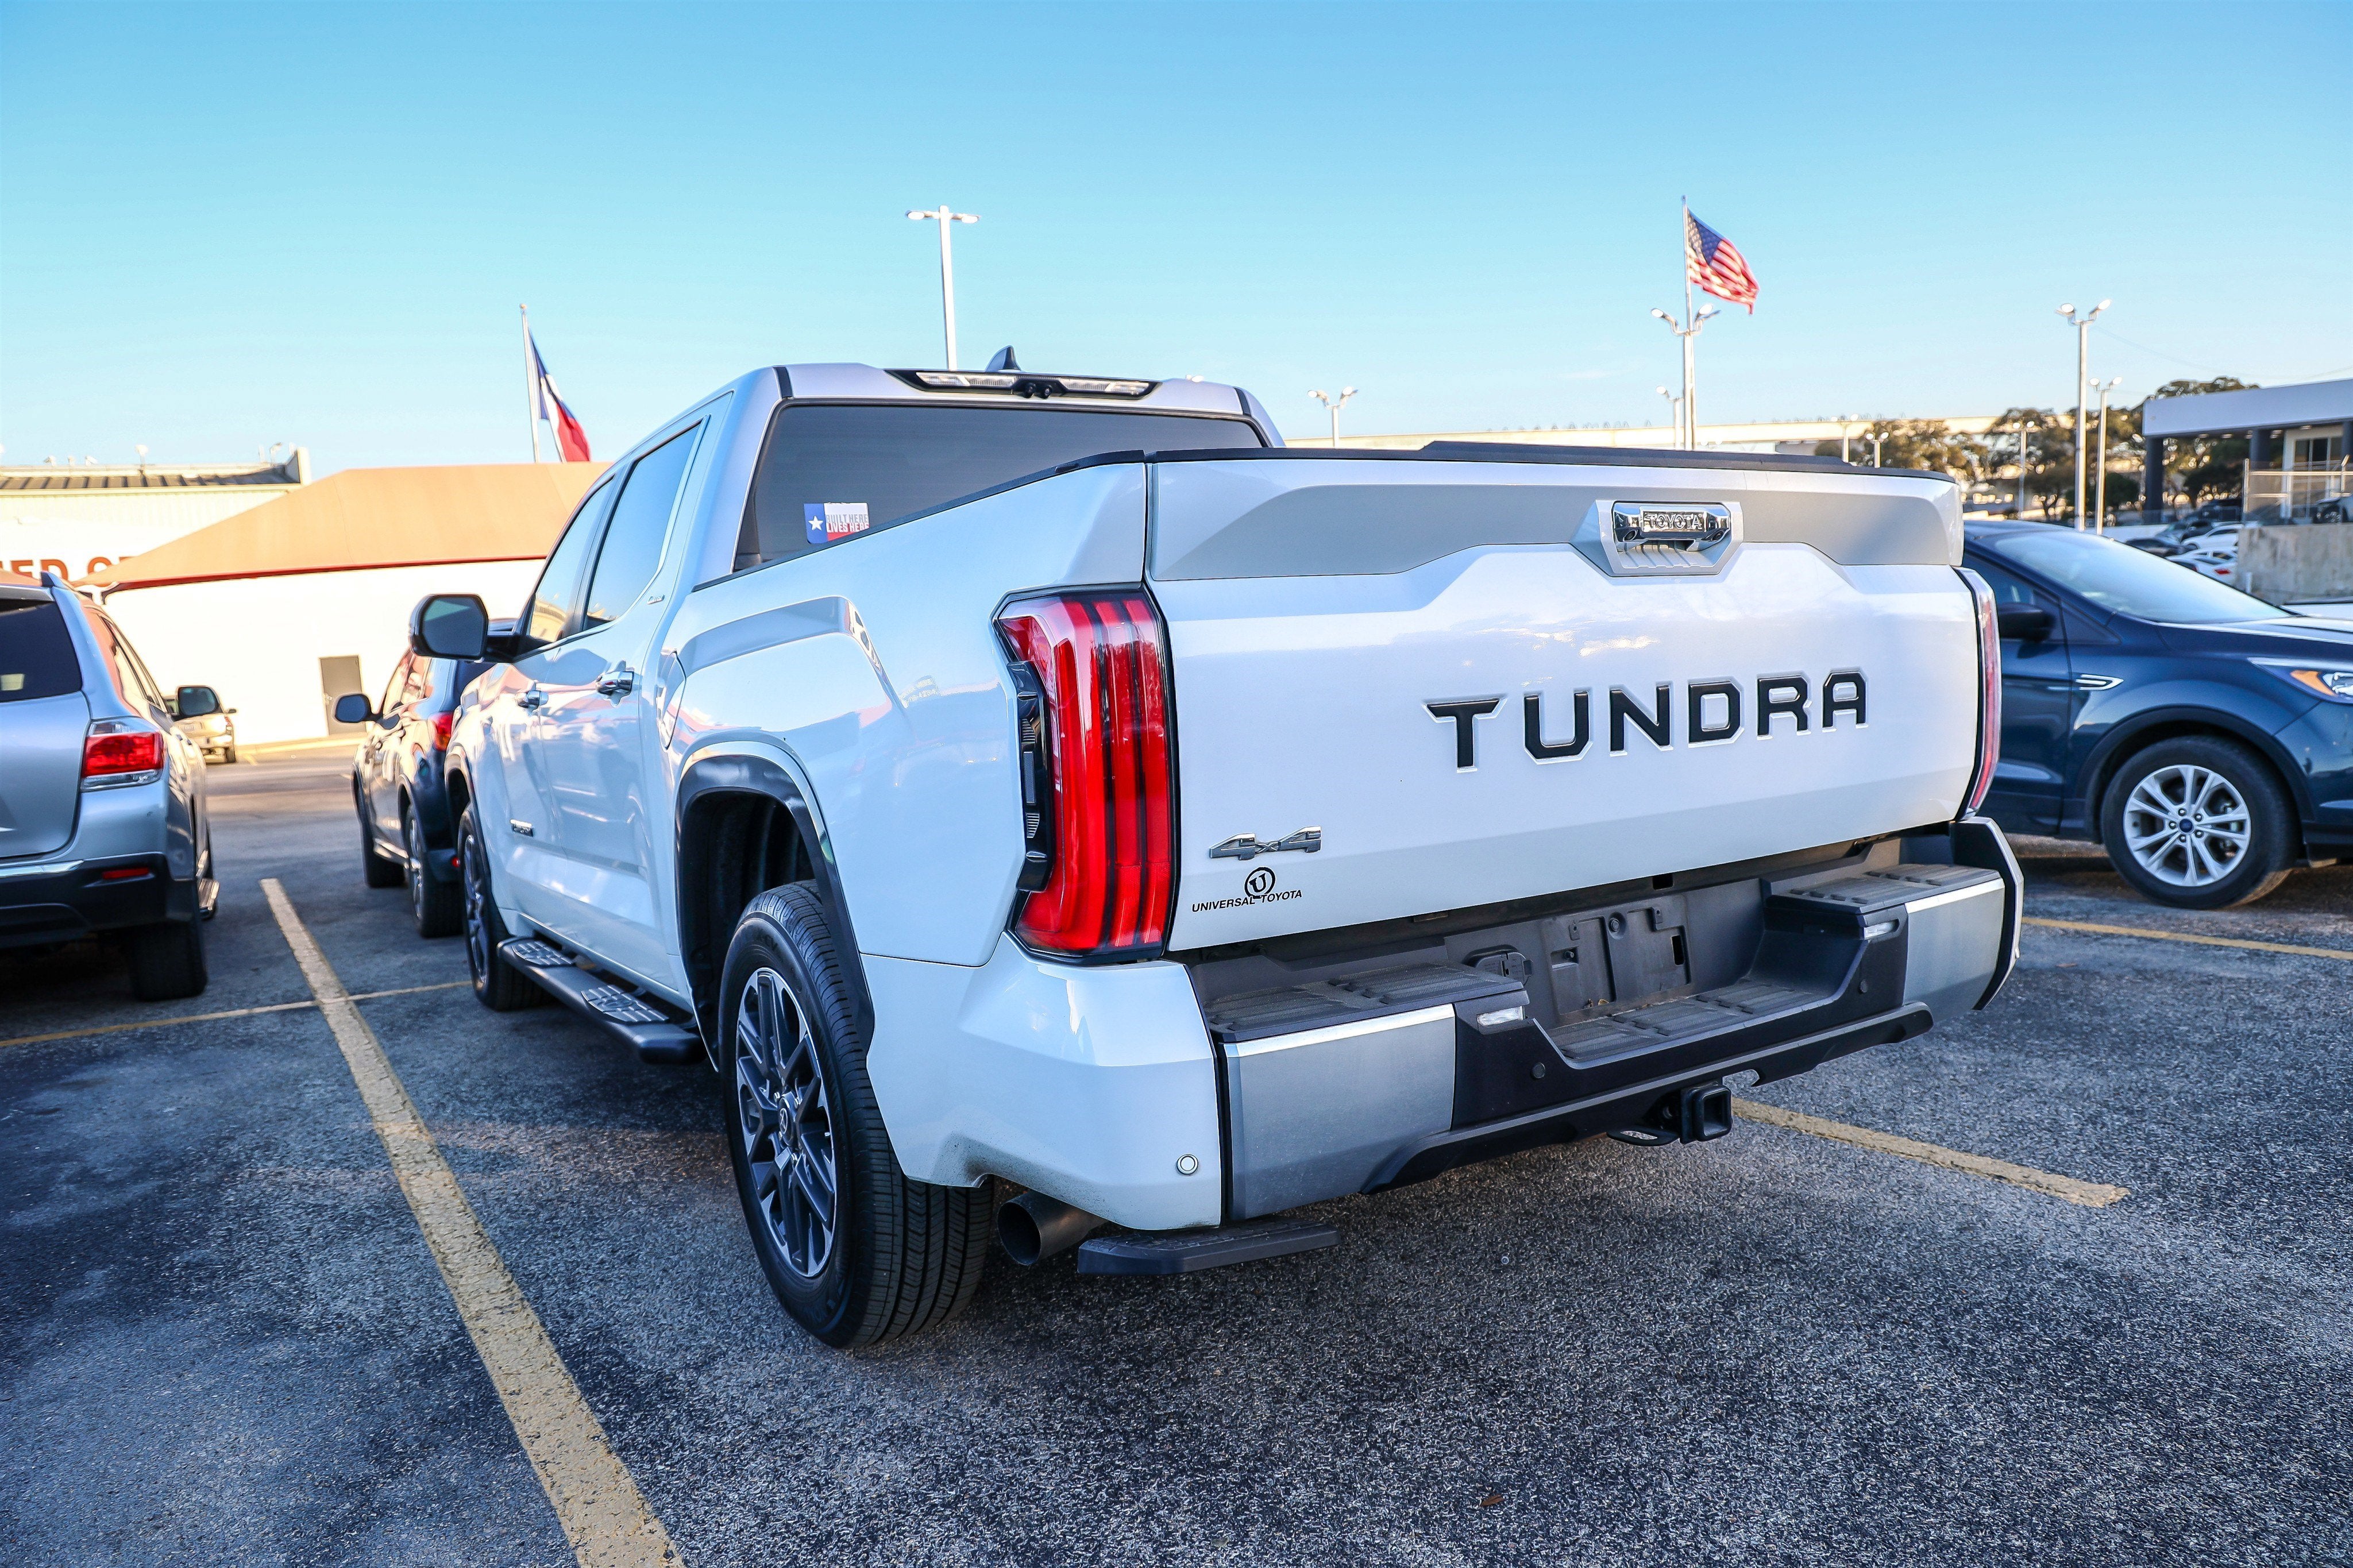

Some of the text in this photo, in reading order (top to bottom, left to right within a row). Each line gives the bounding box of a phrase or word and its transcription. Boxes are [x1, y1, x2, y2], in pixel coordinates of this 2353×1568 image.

[826, 514, 869, 523] BUILT HERE
[1646, 513, 1703, 530] TOYOTA
[827, 523, 847, 532] LIVES
[1422, 669, 1869, 772] TUNDRA
[1192, 890, 1302, 912] UNIVERSAL TOYOTA
